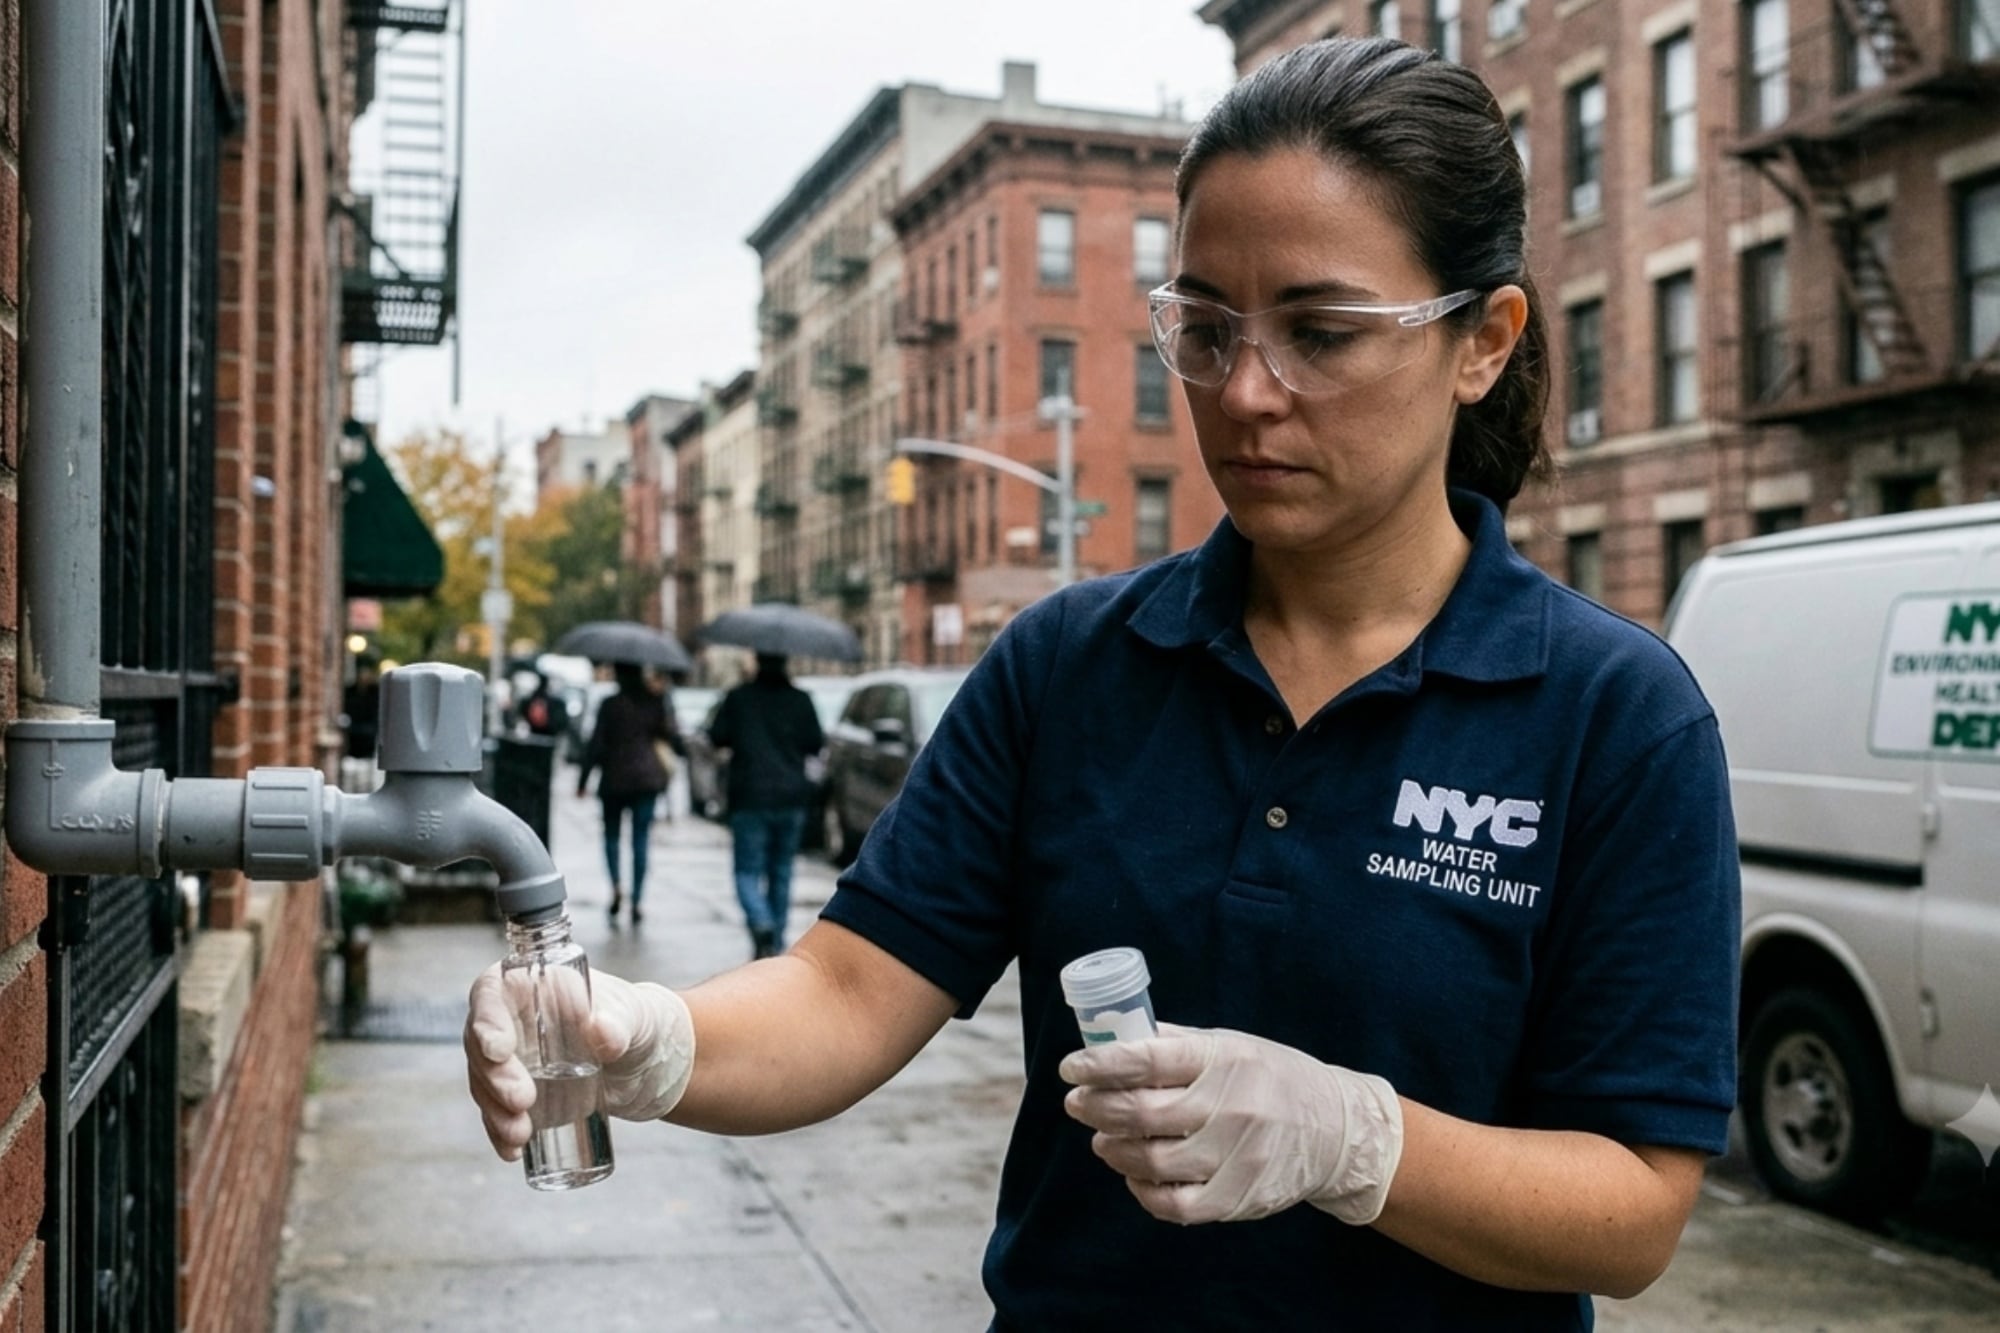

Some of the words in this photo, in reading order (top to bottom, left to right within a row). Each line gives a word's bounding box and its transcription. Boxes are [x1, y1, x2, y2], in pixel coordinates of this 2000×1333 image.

[1393, 779, 1542, 848] NYC
[1366, 853, 1481, 896] SAMPLING
[1488, 878, 1541, 908] UNIT
[1423, 838, 1498, 873] WATER
